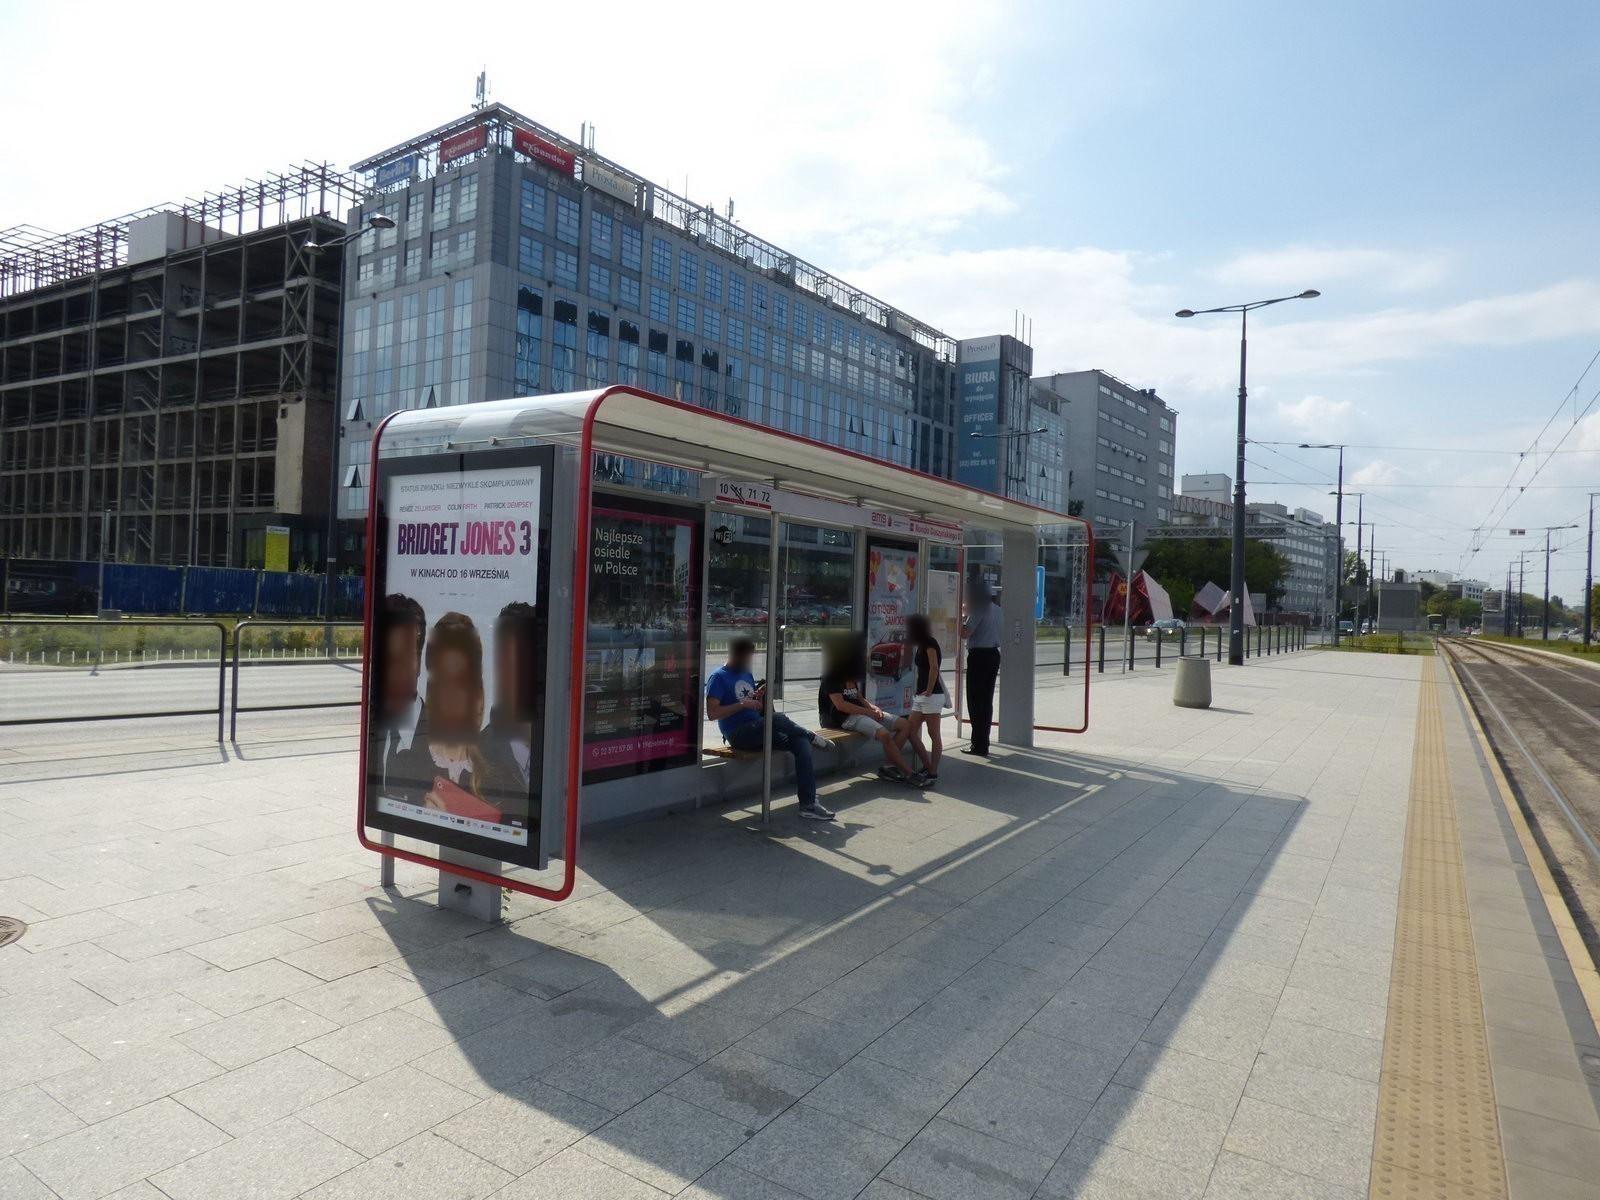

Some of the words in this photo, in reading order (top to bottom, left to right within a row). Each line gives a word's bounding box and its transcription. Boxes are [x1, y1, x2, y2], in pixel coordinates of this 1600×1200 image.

[522, 141, 567, 166] expander
[965, 371, 996, 384] BIURA
[964, 413, 994, 423] OFFICES
[480, 478, 534, 489] SKOMPLIKOWANY
[720, 483, 729, 495] 10
[748, 488, 757, 500] 71
[761, 491, 770, 503] 72
[462, 503, 478, 511] FIRTH
[484, 502, 506, 510] PATRICK
[506, 501, 533, 509] DEMPSEY
[872, 511, 887, 524] ams
[398, 522, 459, 555] BRIDGET
[460, 520, 516, 555] JONES
[519, 520, 532, 555] 3
[595, 528, 643, 545] Najlepsze
[594, 545, 630, 559] osiedle
[410, 569, 418, 578] W
[419, 568, 446, 579] KINACH
[447, 569, 458, 578] OD
[460, 569, 468, 578] 16
[469, 567, 510, 579] WRZEŚNIA
[594, 564, 603, 574] w
[605, 561, 638, 576] Polsce
